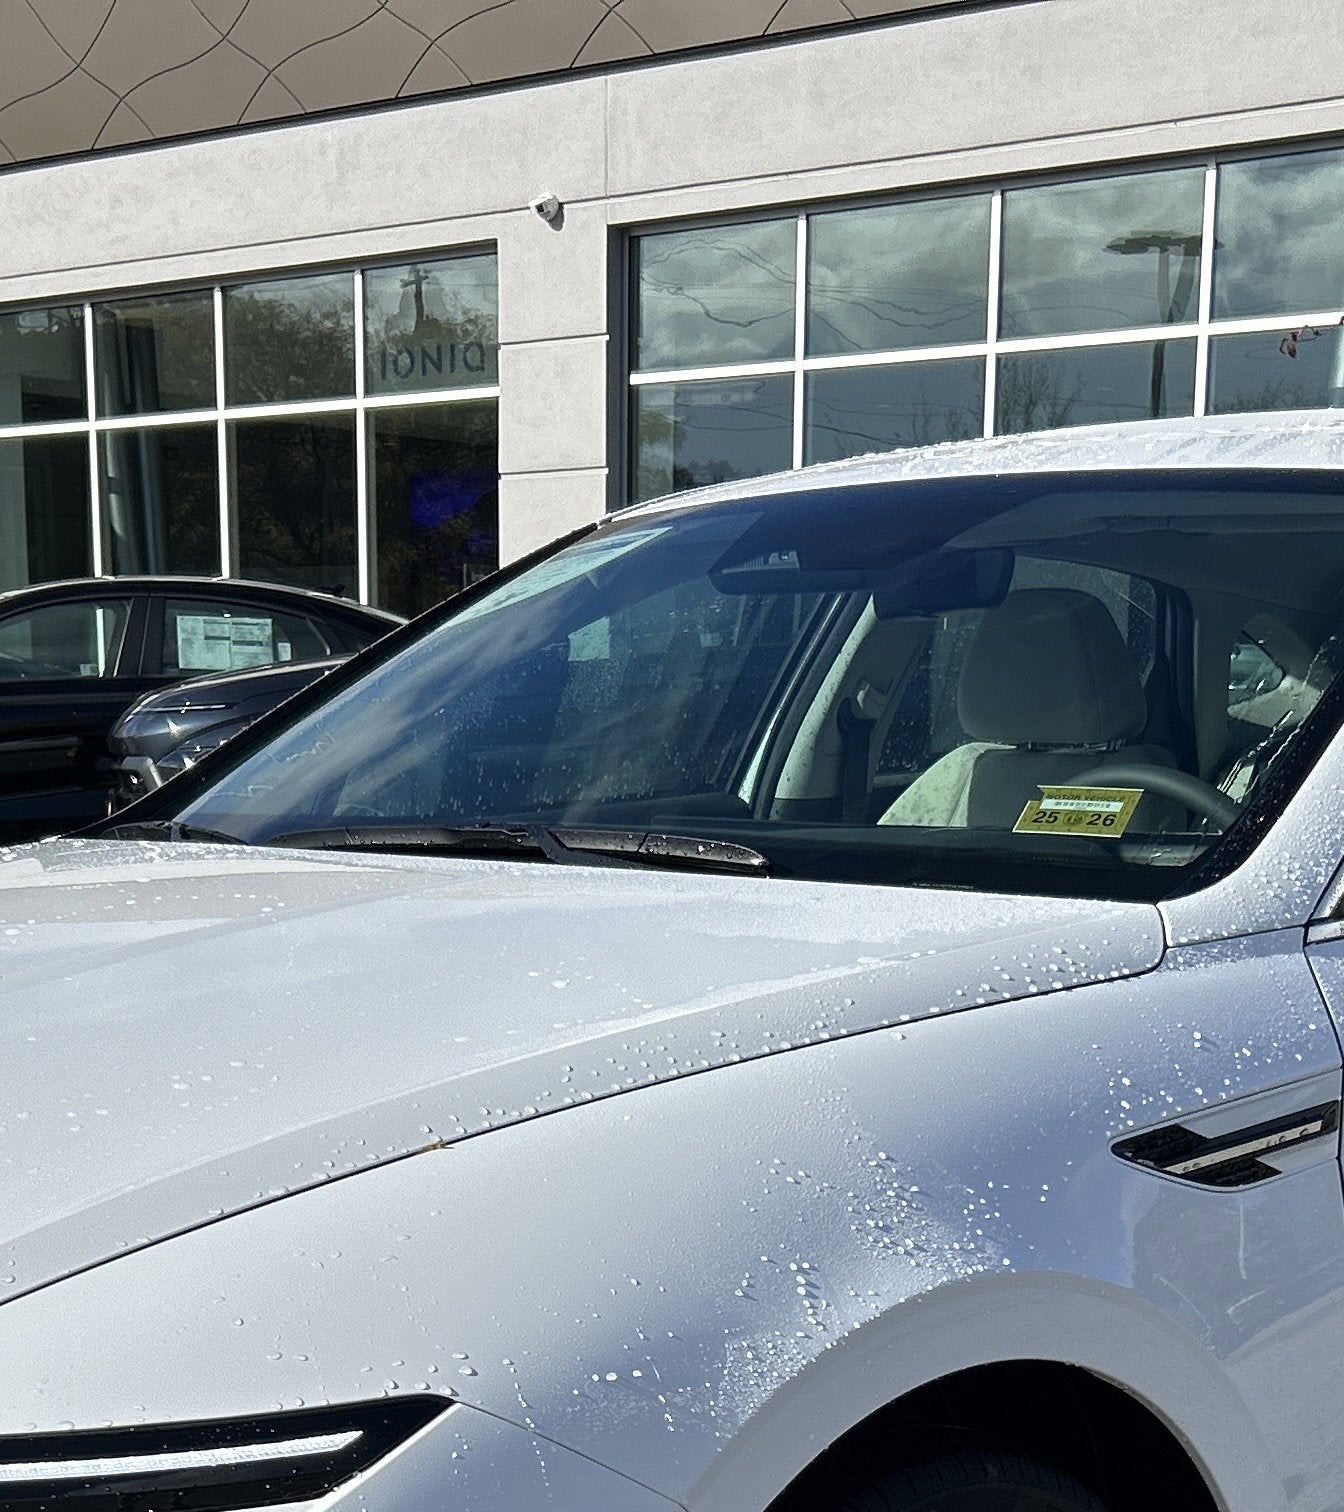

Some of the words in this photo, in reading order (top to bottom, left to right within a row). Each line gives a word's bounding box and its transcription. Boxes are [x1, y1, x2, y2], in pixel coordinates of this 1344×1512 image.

[380, 341, 485, 381] IONIQ
[1032, 810, 1060, 824] 25
[1087, 813, 1117, 827] 26
